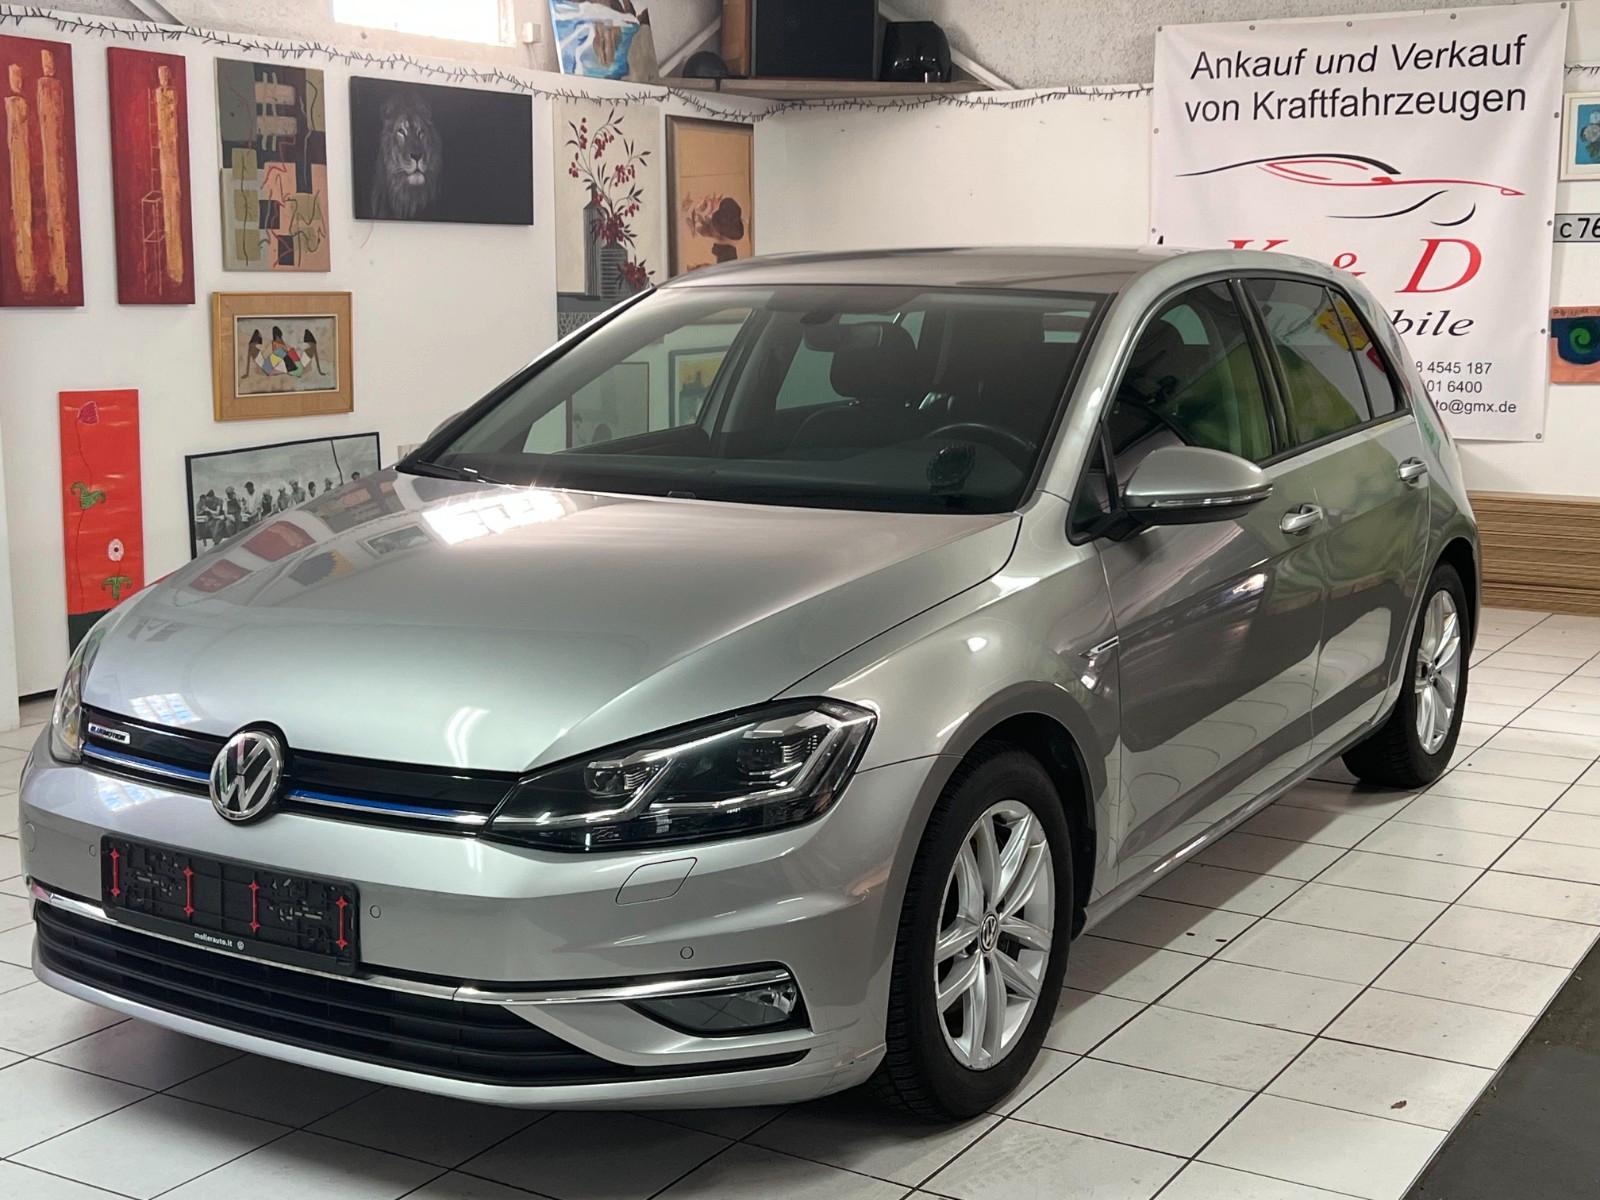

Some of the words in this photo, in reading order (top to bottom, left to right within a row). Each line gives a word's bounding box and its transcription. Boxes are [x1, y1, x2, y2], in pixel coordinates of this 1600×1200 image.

[1190, 48, 1308, 80] Ankauf
[1314, 45, 1378, 75] und
[1391, 33, 1528, 71] Verkauf
[1184, 99, 1240, 122] von
[1252, 87, 1527, 122] Kraftfahrzeugen
[1394, 238, 1482, 293] D
[1392, 309, 1475, 337] bile
[1427, 361, 1461, 374] 4545
[1467, 362, 1492, 375] 187
[1426, 380, 1442, 393] 01
[1447, 380, 1483, 394] 6400
[1435, 399, 1517, 415] to@gmx.de
